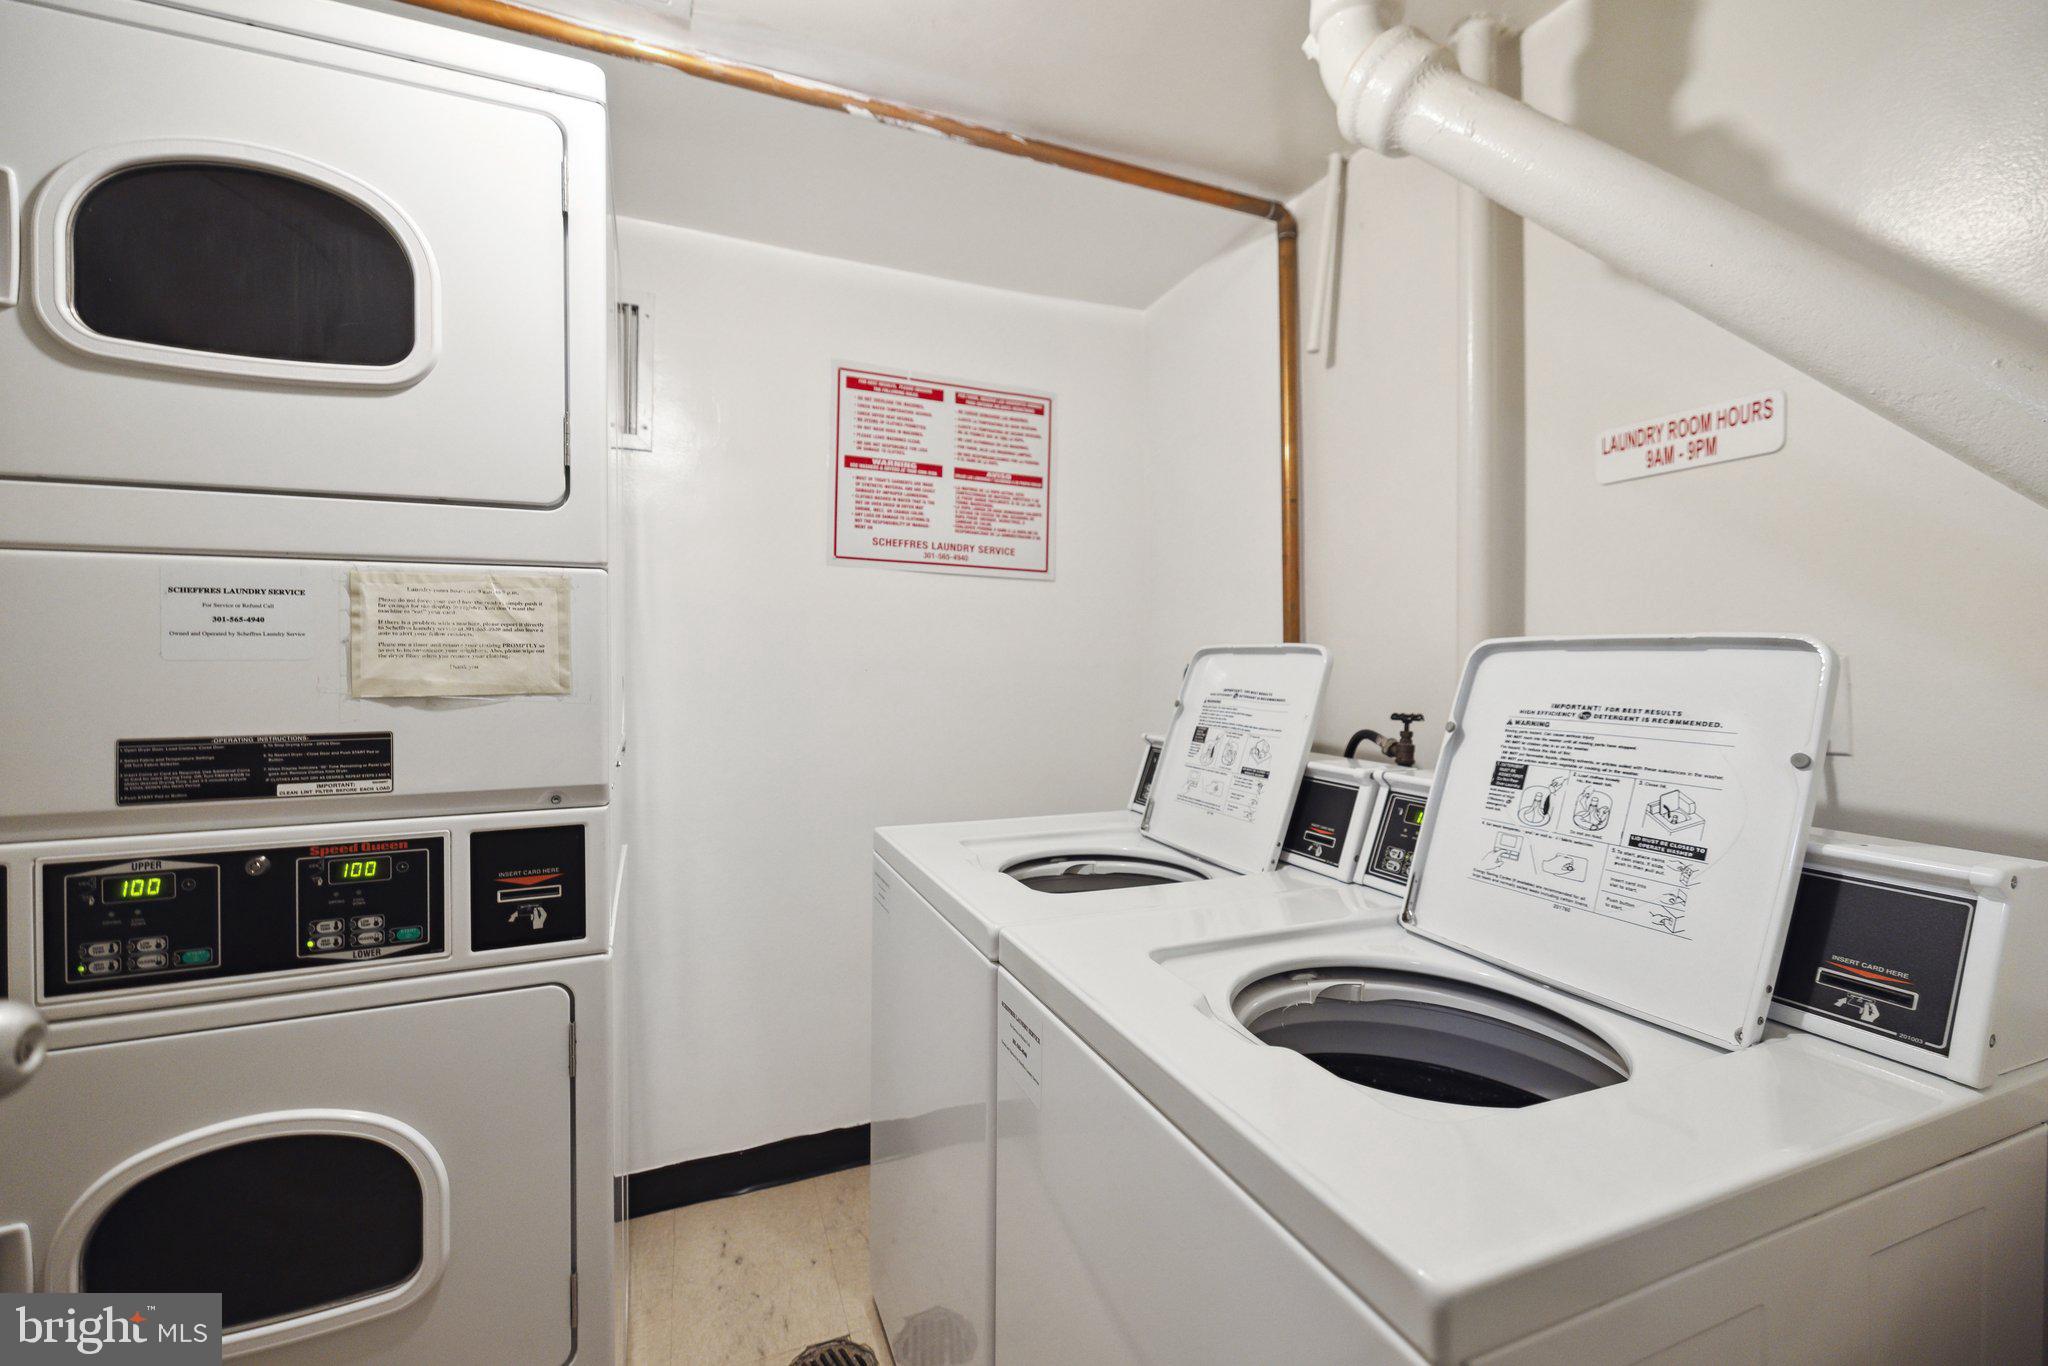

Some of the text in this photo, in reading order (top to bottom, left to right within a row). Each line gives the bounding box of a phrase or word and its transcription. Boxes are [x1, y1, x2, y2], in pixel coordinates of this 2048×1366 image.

[1601, 398, 1774, 456] LAUNDRY ROOM HOURS
[1646, 445, 1675, 469] 9AM
[1688, 436, 1718, 461] 9PM
[872, 537, 1016, 556] SCHEFFRES LAUNDRY SERVICE
[923, 552, 969, 562] 301-565-4940
[167, 586, 306, 596] SCHEFFRES LAUNDRY SERVICE
[1536, 710, 1576, 718] EFFICIENCY
[1593, 713, 1640, 723] DETERGENT
[1651, 717, 1724, 729] RECOMMENDED.
[1644, 709, 1682, 717] RESULTS
[1515, 720, 1550, 728] WARNING
[310, 840, 408, 857] Speed Queen
[1641, 836, 1660, 846] MUST
[1670, 842, 1695, 852] CLOSED
[131, 861, 162, 871] UPPER
[343, 861, 377, 878] 100
[498, 870, 522, 878] INSERT
[122, 878, 161, 898] 100
[352, 948, 381, 959] LOWER
[1832, 954, 1910, 980] INSERT CARD HERE
[1898, 1032, 1924, 1045] 201003
